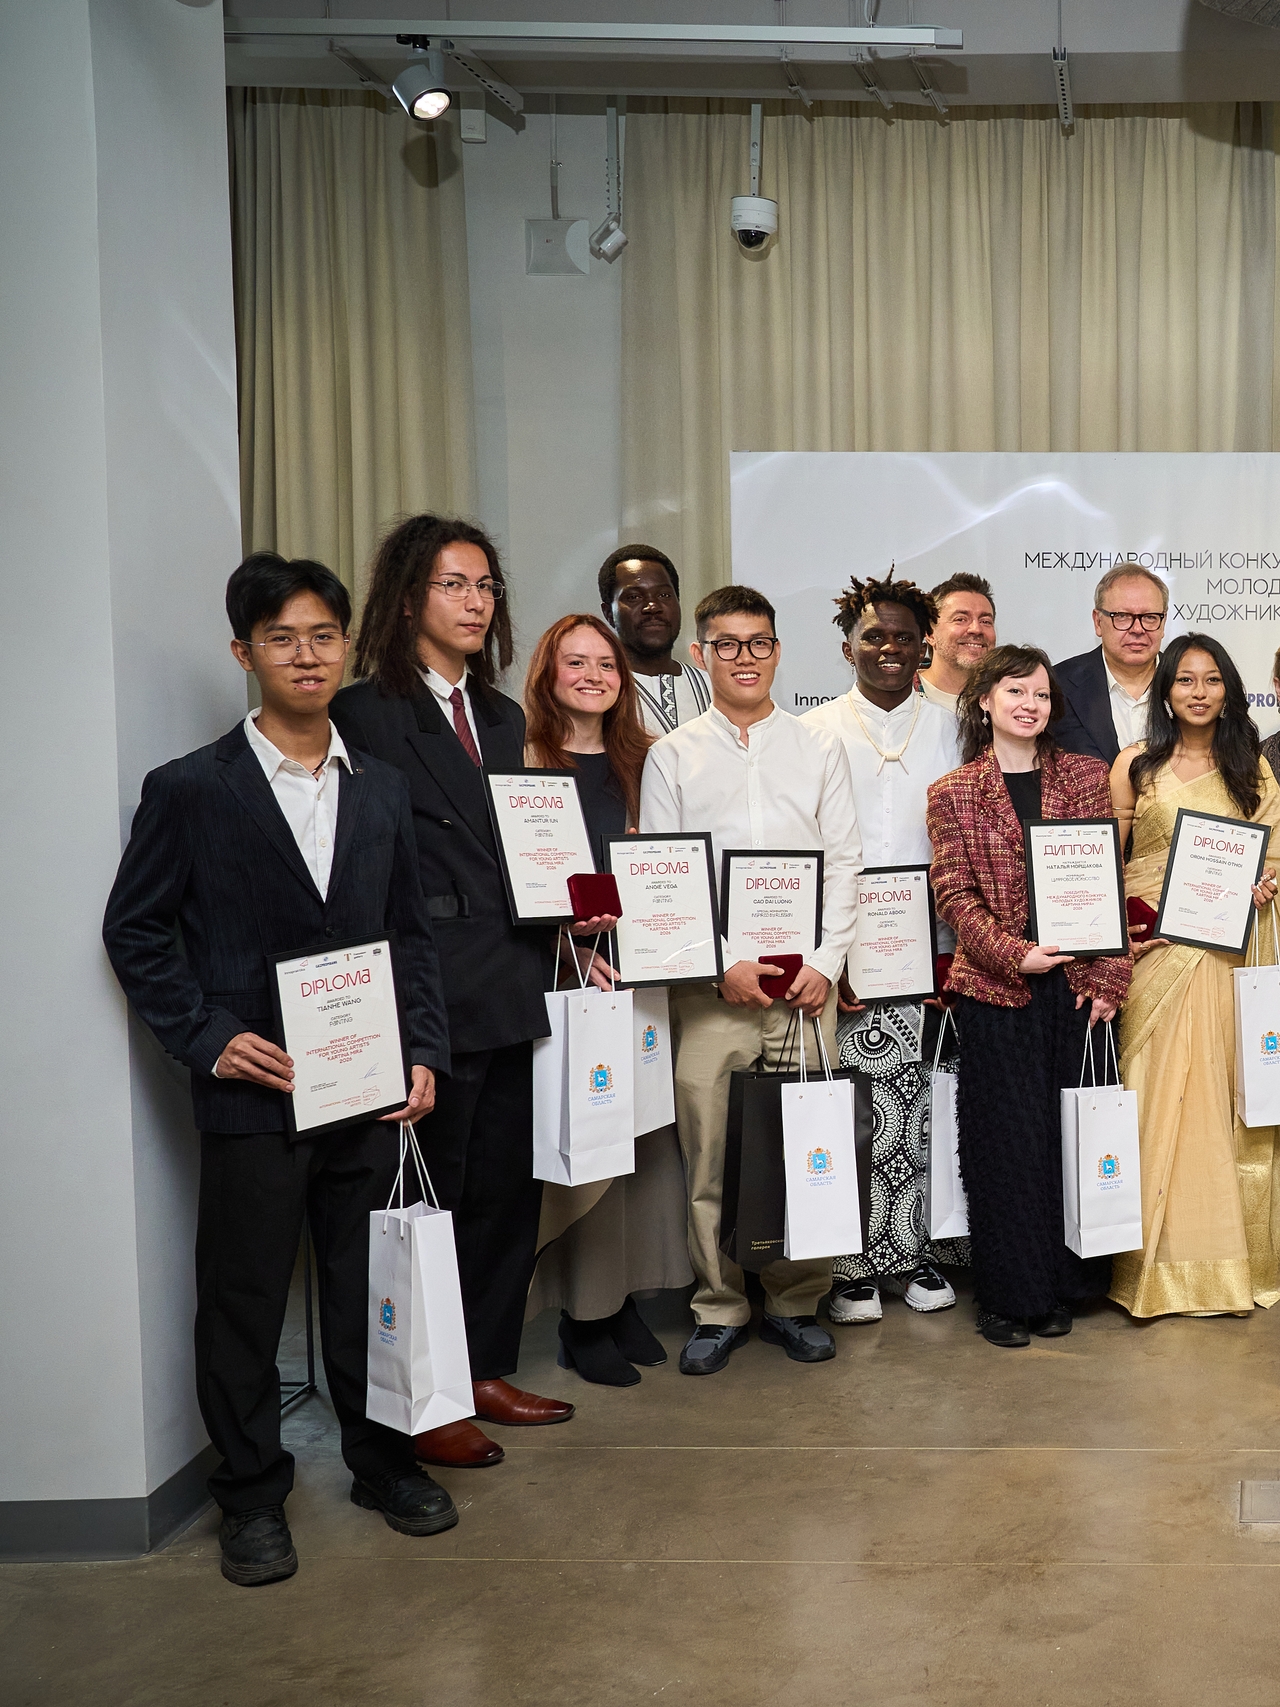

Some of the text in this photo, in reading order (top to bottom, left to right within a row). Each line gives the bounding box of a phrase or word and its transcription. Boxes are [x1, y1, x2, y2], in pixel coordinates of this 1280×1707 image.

[1025, 549, 1213, 571] МЕЖДУНАРОДНЫЙ
[509, 796, 564, 808] DIPLOMa
[1043, 844, 1103, 856] ДИПЛОМ
[1193, 835, 1245, 855] DIPLOMa
[1205, 857, 1227, 865] HOSSAIN
[630, 862, 689, 875] DIPLOMa
[746, 878, 800, 890] DIPLOMa
[859, 890, 912, 904] DIPLOMa
[301, 968, 371, 998] DIPLOMa
[317, 997, 362, 1012] TIANHE WANG
[306, 1034, 380, 1056] INTERNATIONAL COMPETITION
[330, 1036, 349, 1045] WINNER
[319, 1042, 369, 1059] FOR YOUNG ARTISTS
[327, 1048, 363, 1061] KARTINA MIRA
[805, 1175, 837, 1183] САМАРСКАЯ
